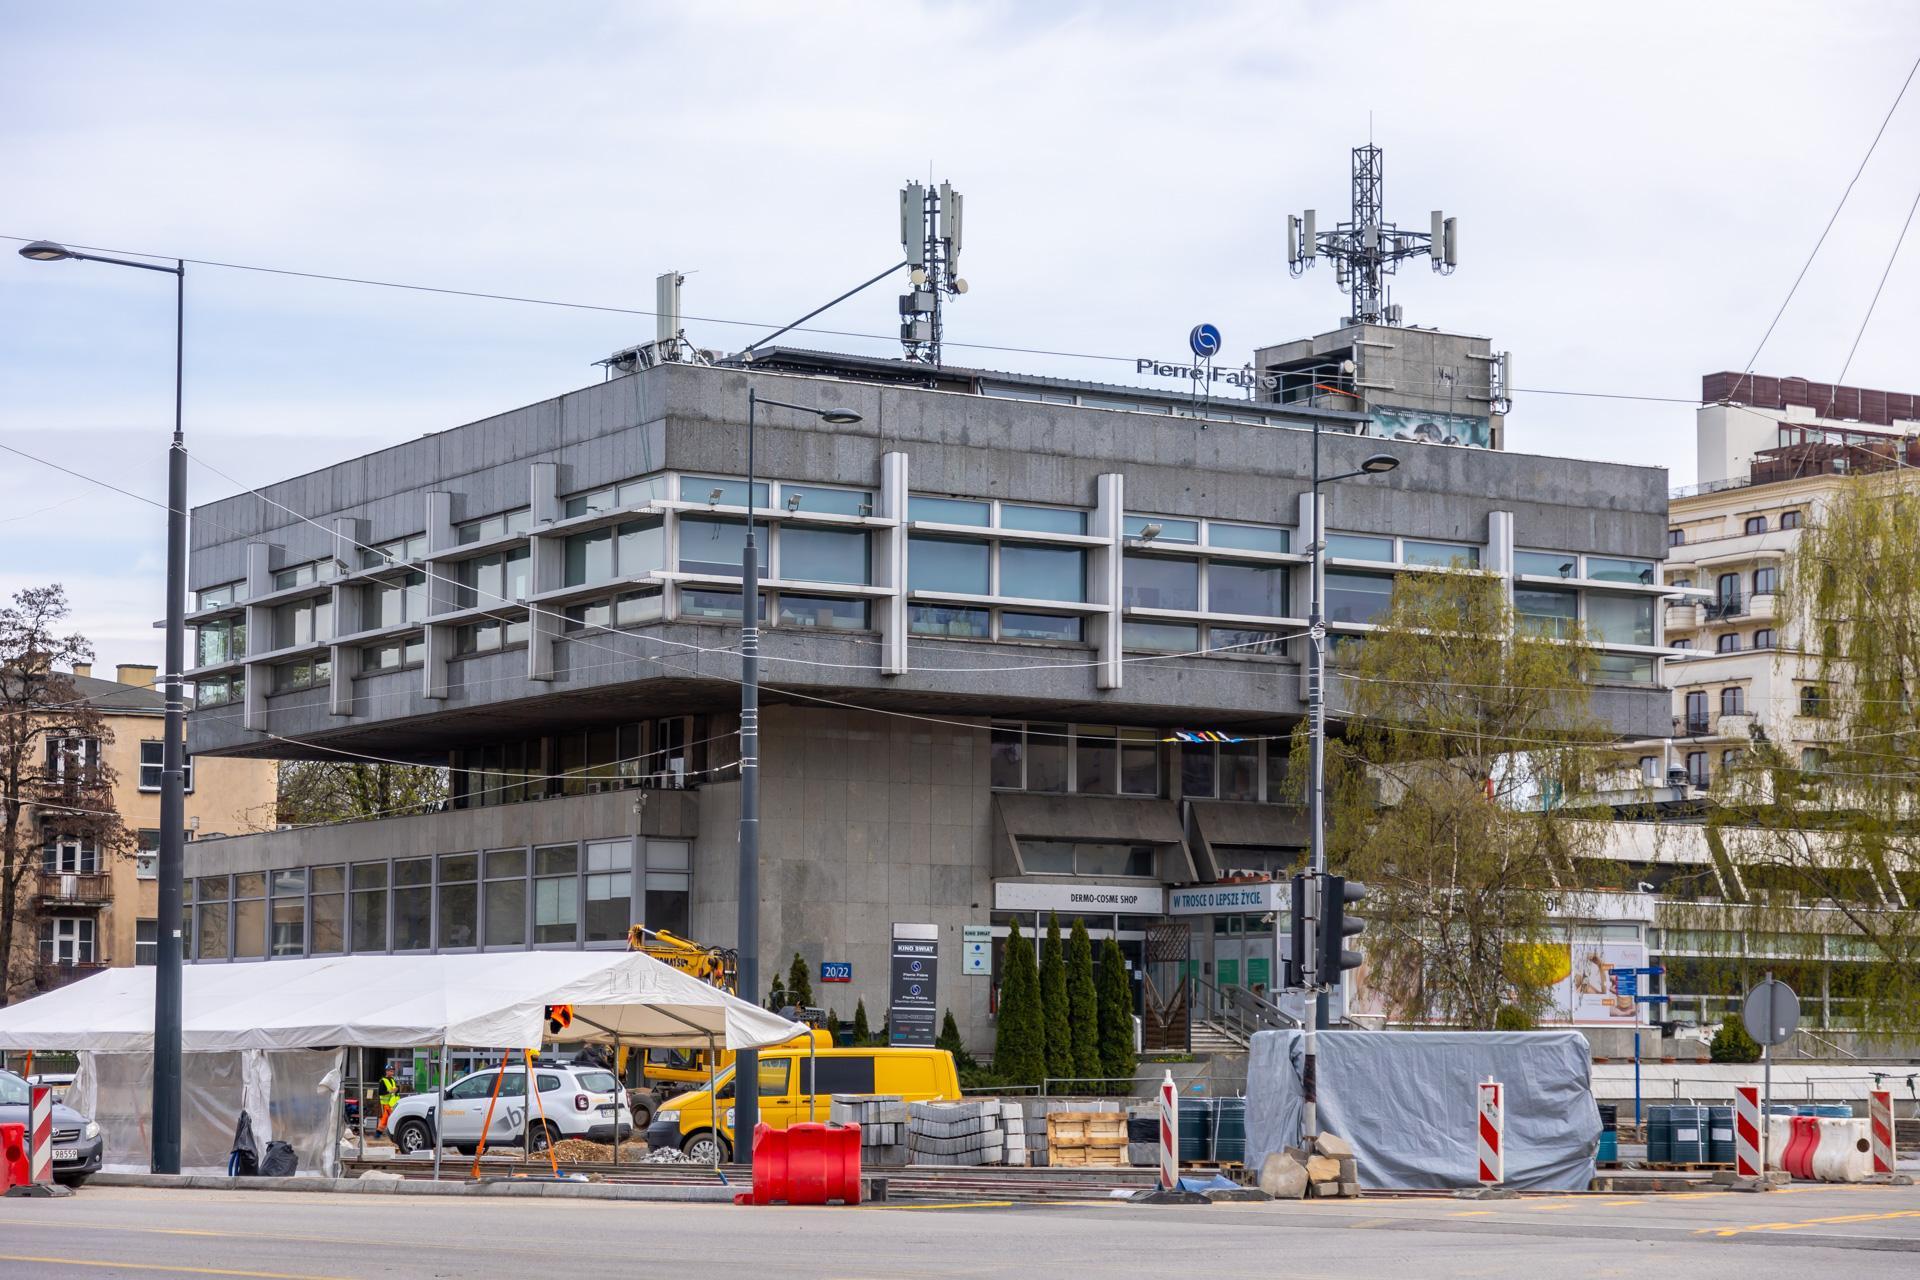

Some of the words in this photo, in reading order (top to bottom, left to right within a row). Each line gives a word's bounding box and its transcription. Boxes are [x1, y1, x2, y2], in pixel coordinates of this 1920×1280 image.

[1137, 359, 1204, 380] Pierre
[1212, 366, 1278, 389] Fabre
[1070, 893, 1119, 904] DERMO-COSME
[1120, 895, 1138, 904] SHOP
[1173, 895, 1181, 908] W
[1182, 894, 1207, 908] TROSCE
[1208, 894, 1214, 907] O
[1216, 892, 1239, 906] LEPSZE
[1240, 889, 1263, 905] ŻYCIE.
[897, 944, 914, 952] KINO
[825, 966, 849, 978] 20/22
[55, 1150, 77, 1159] 98559
